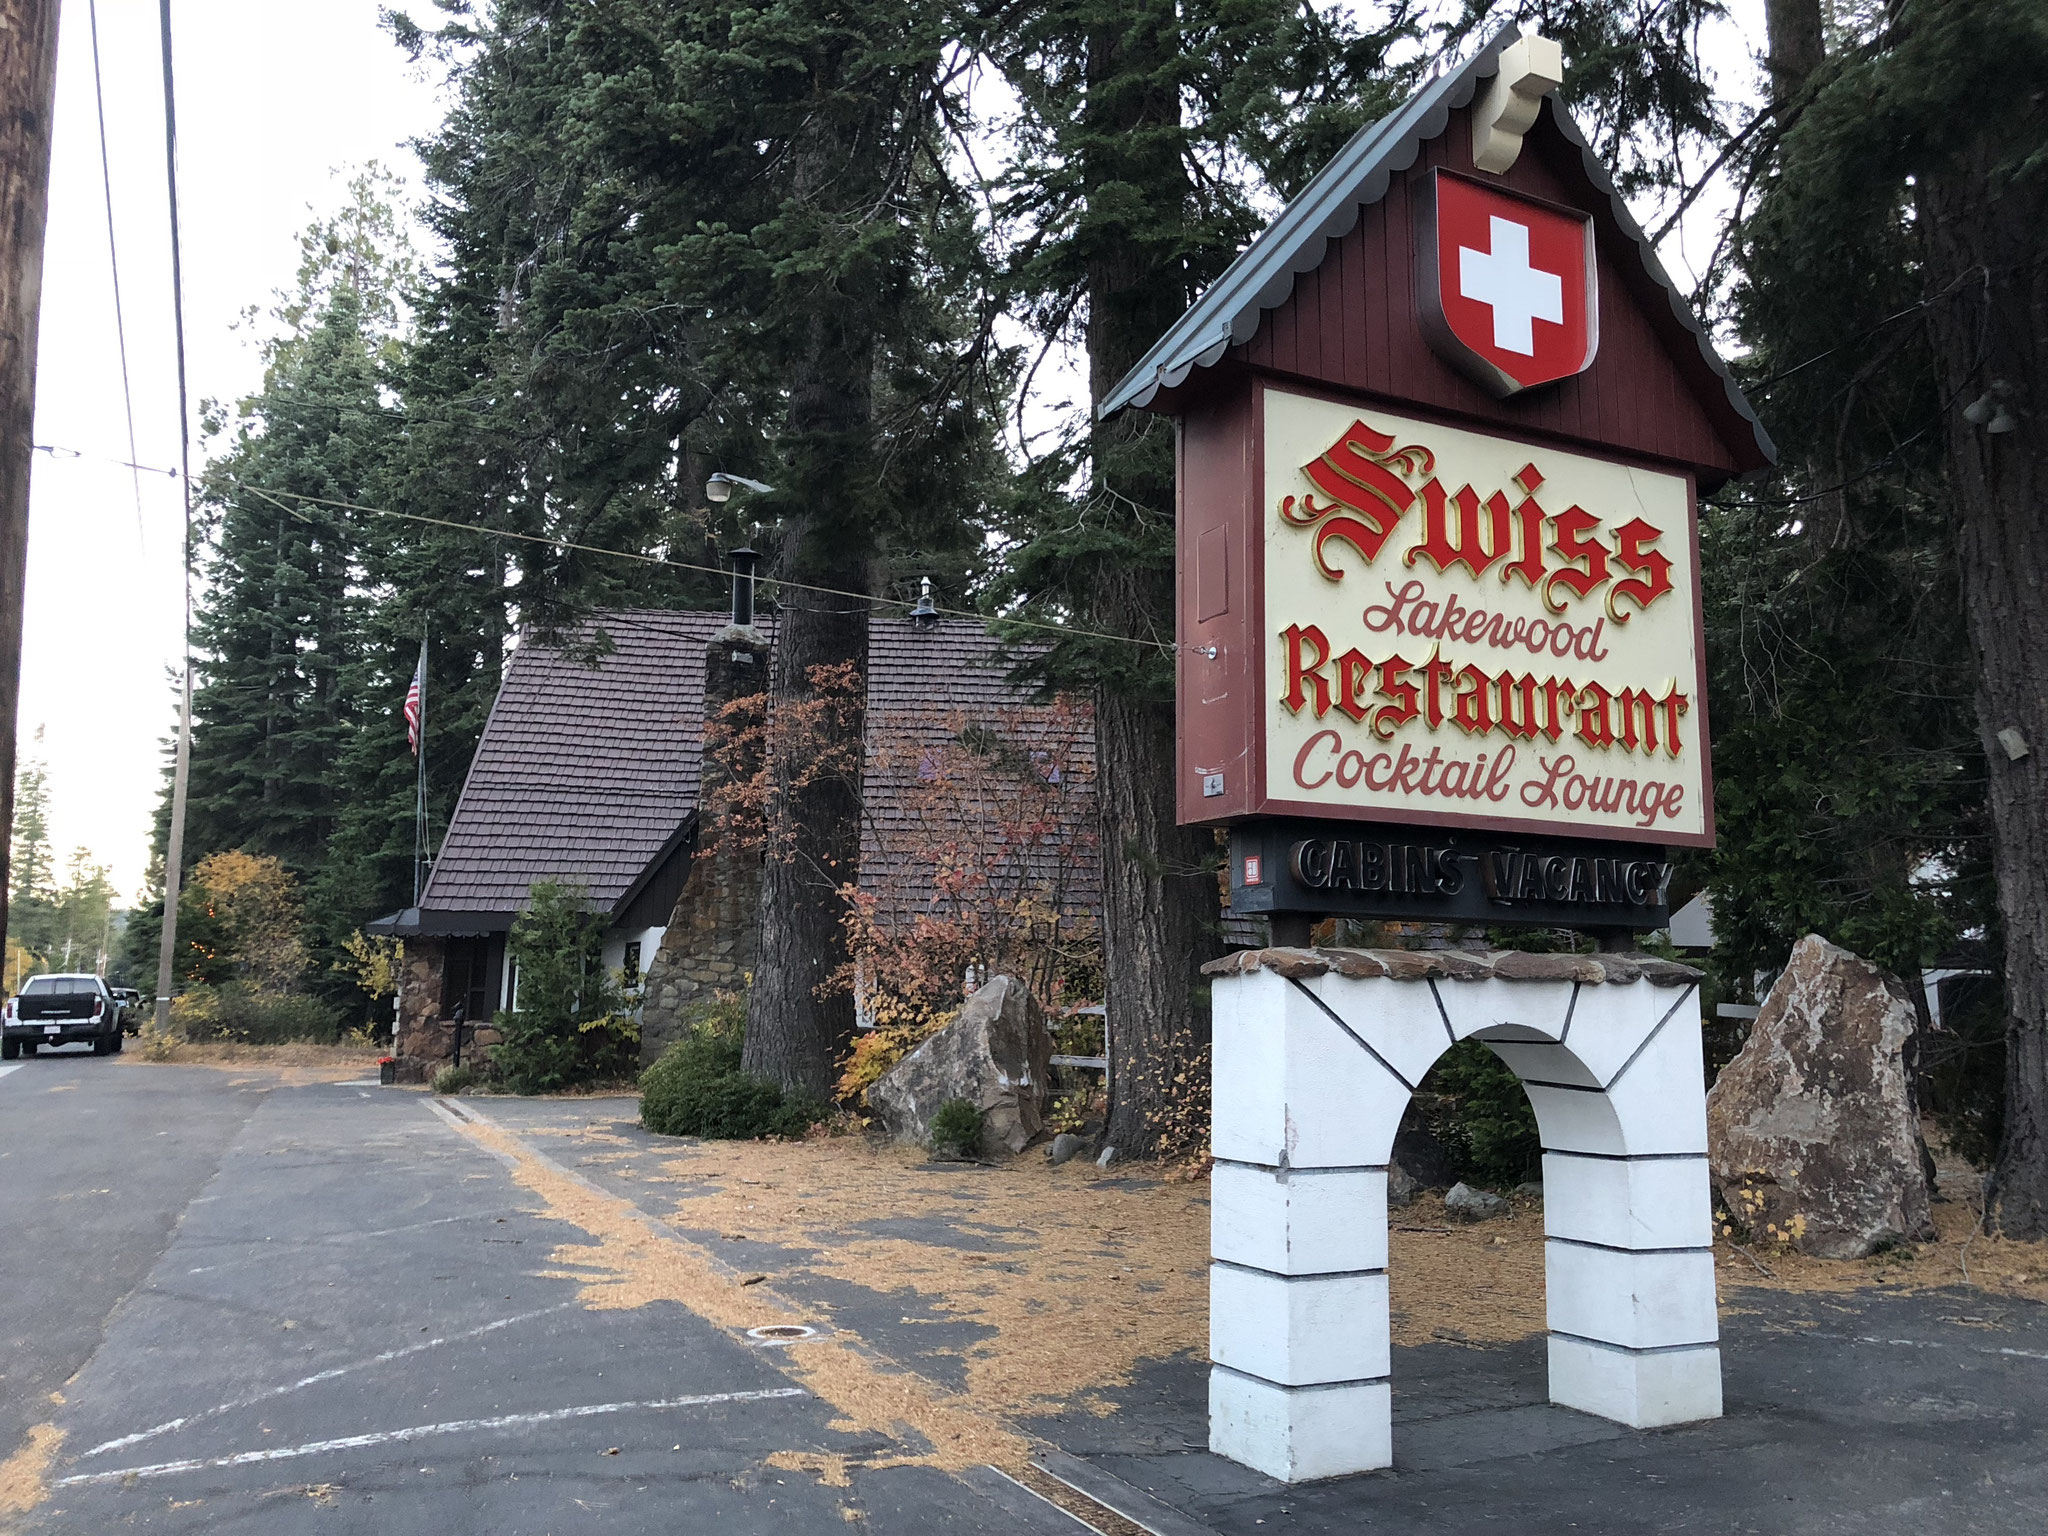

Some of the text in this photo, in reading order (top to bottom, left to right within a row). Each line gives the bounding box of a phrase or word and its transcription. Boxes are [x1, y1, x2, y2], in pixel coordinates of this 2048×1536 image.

[1278, 418, 1675, 625] Swiss
[1363, 580, 1609, 662] Lakewood
[1279, 623, 1690, 760] Restaurant
[1293, 729, 1685, 827] Cocktail Lounge
[1292, 838, 1673, 907] CABINS VACANCY
